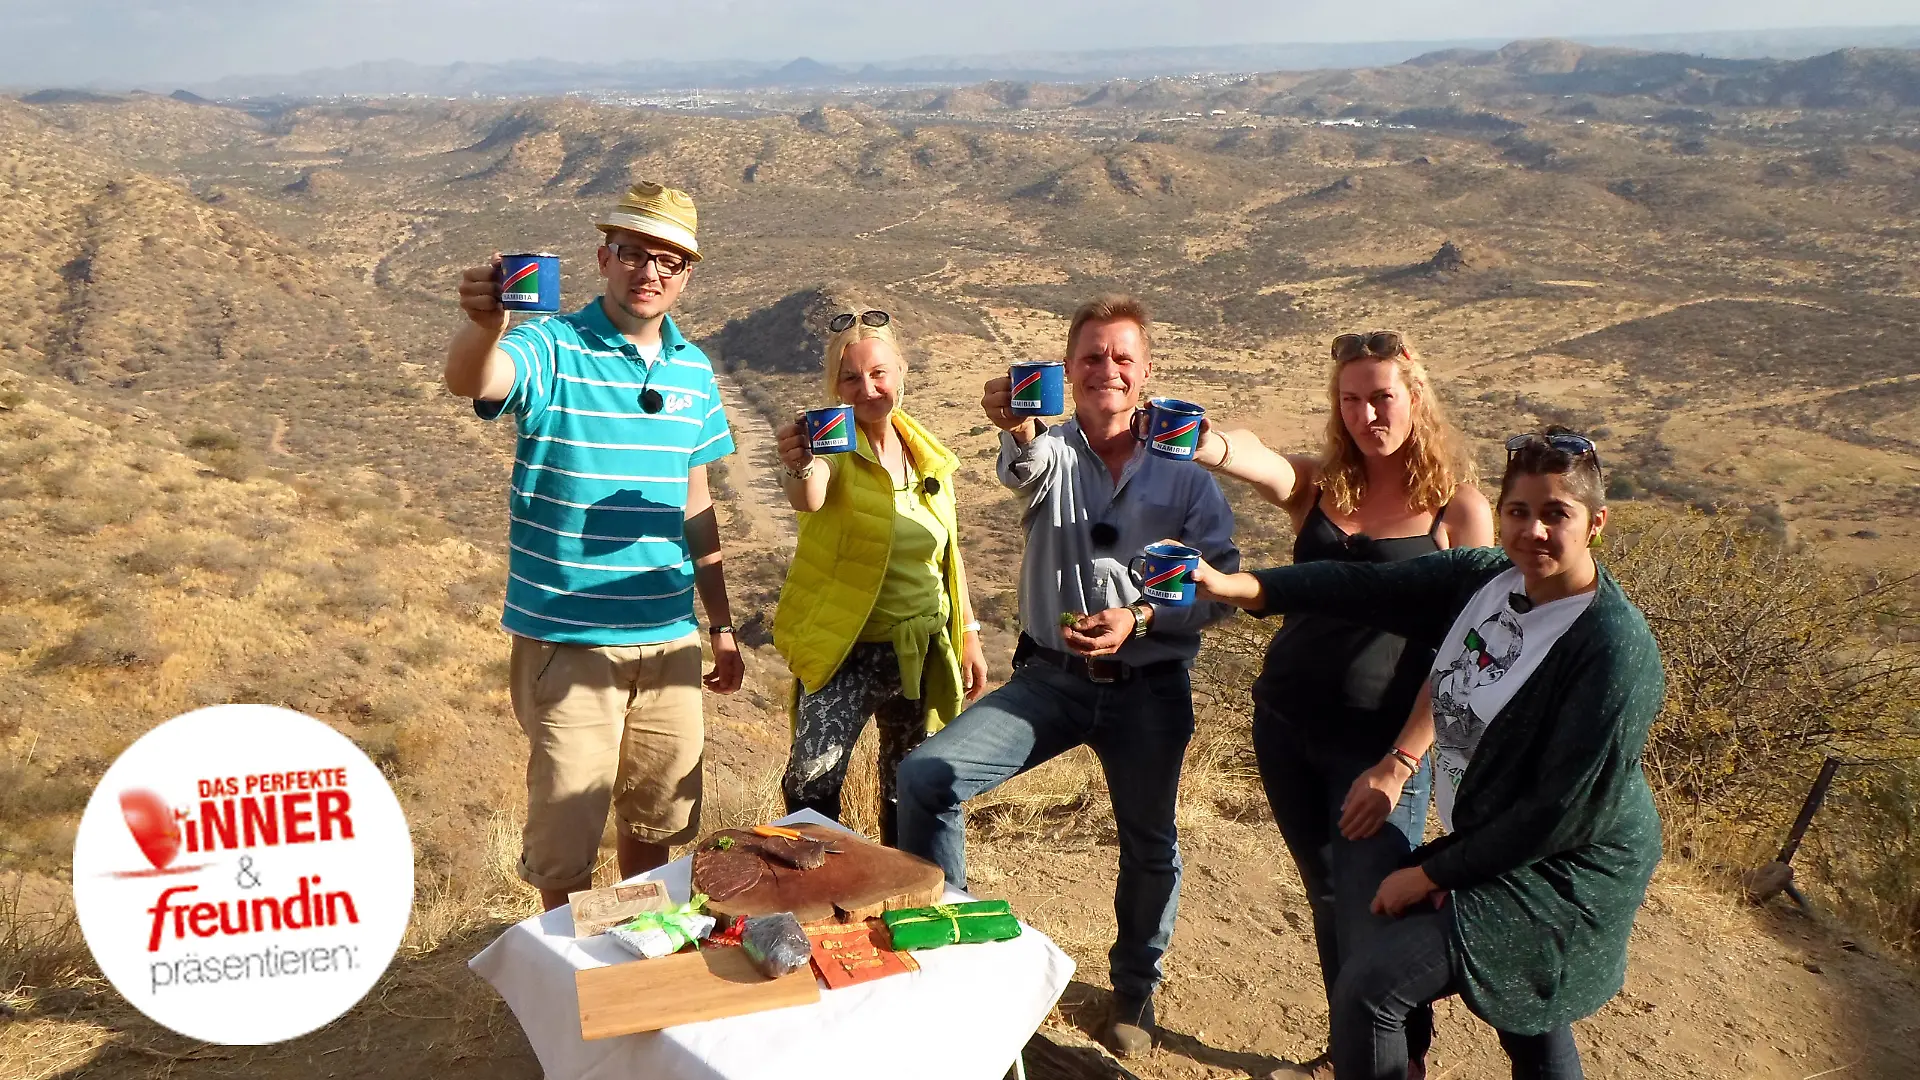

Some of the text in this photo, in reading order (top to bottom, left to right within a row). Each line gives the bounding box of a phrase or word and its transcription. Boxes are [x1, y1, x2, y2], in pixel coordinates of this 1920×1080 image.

[816, 439, 844, 447] NAMIBIA
[1157, 443, 1187, 453] NAMIBIA
[1147, 588, 1177, 599] NAMIBIA
